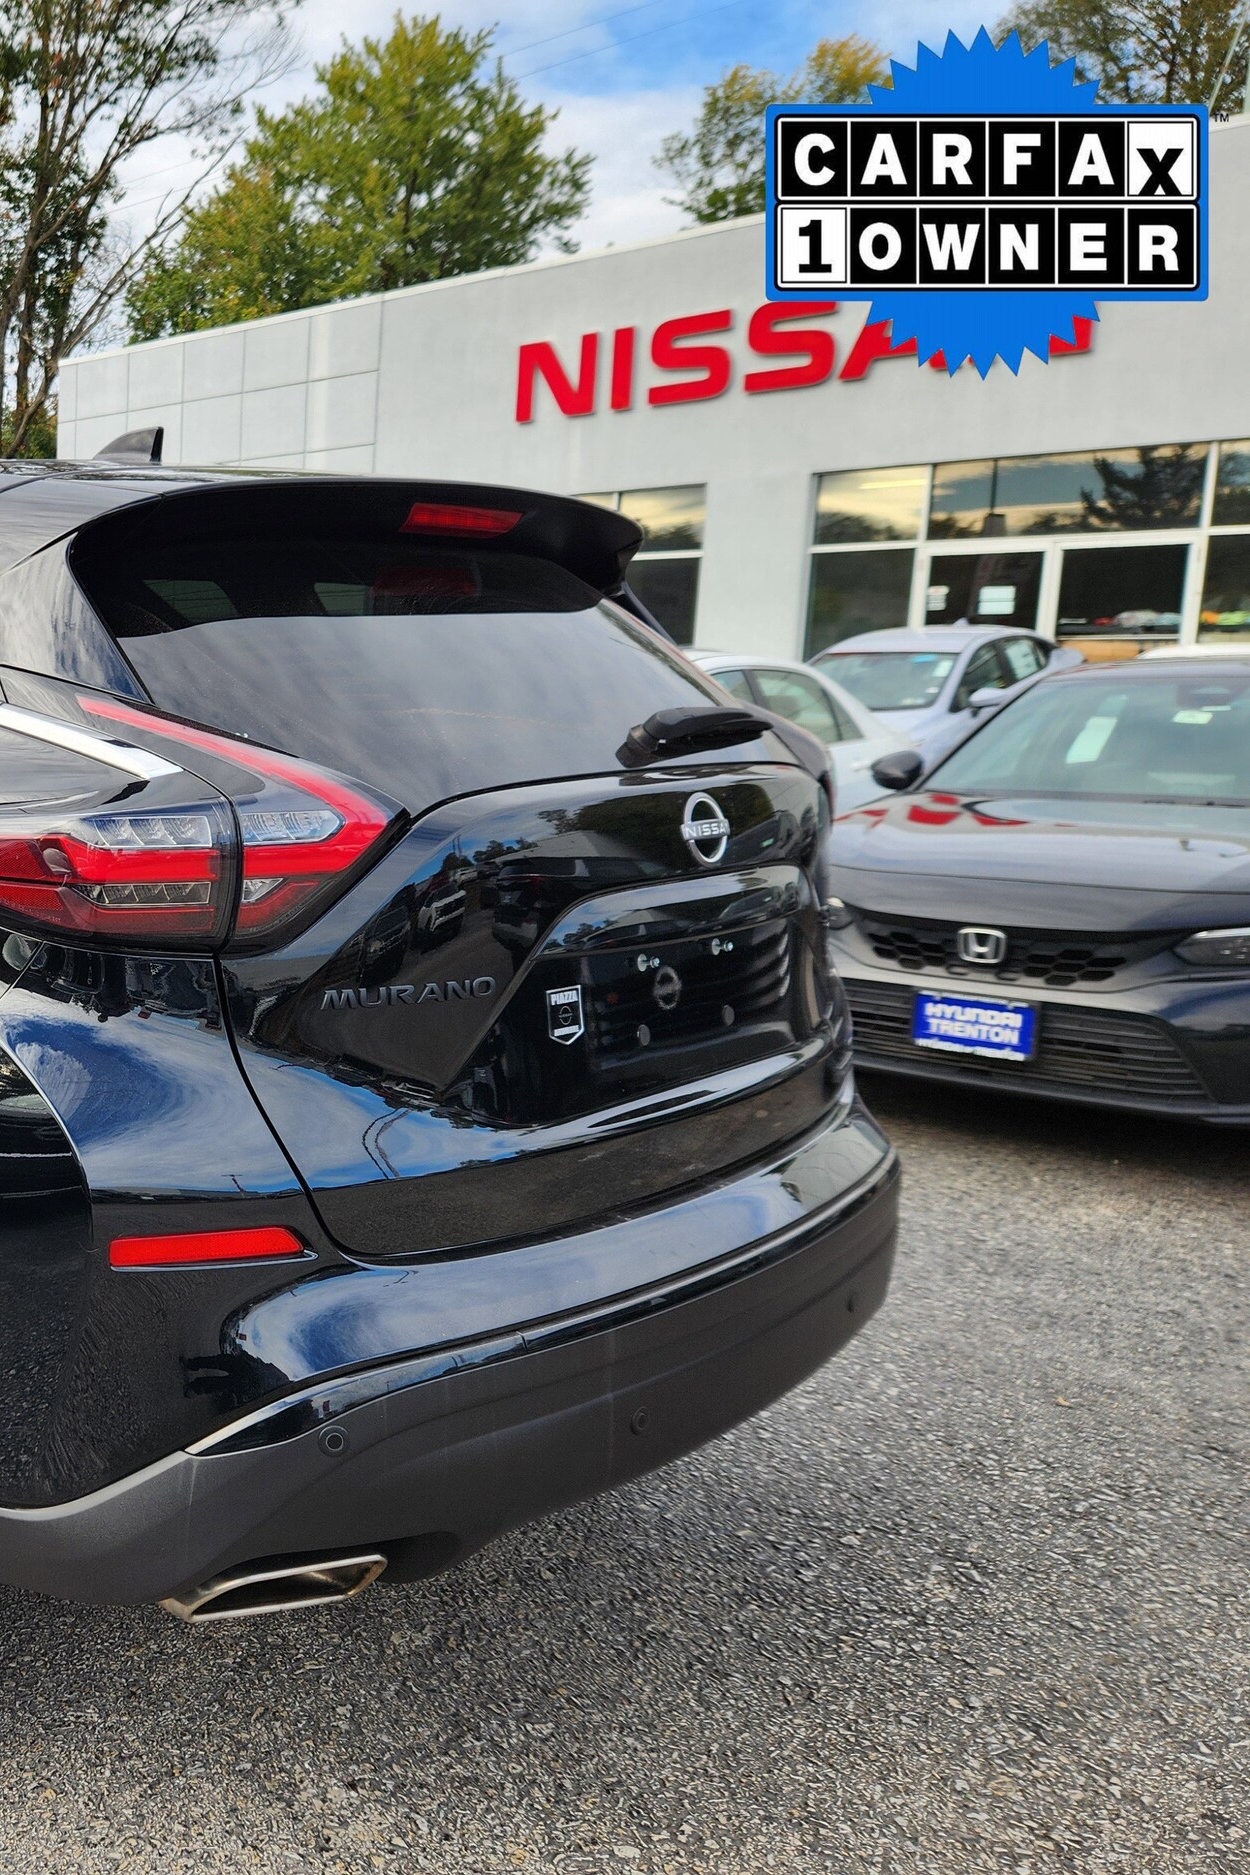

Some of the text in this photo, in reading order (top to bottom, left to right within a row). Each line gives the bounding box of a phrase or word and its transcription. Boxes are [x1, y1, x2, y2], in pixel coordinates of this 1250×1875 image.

[516, 301, 1092, 423] NISS
[320, 976, 496, 1011] MURANO
[925, 1002, 1023, 1028] HYUNDAI
[927, 1018, 1020, 1045] TRENTON
